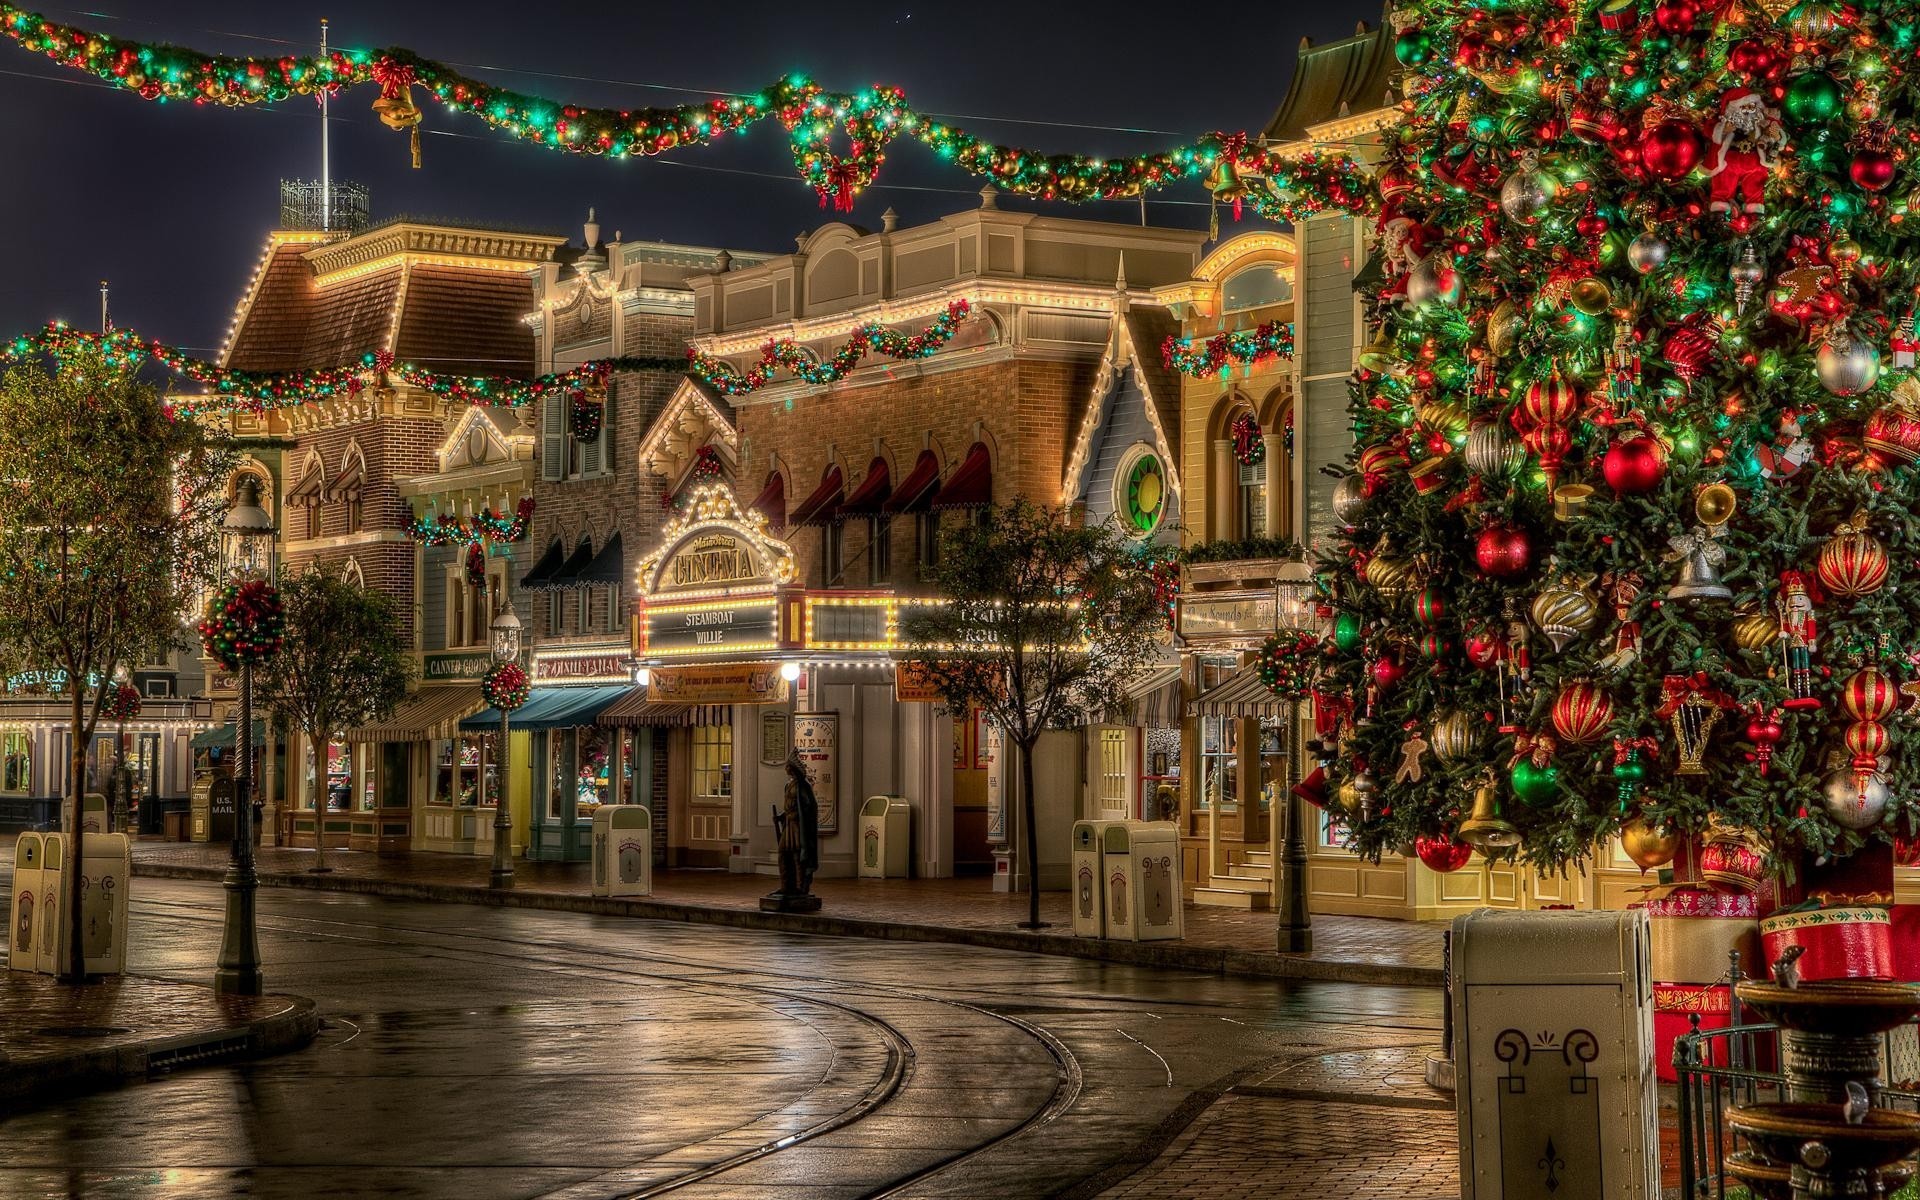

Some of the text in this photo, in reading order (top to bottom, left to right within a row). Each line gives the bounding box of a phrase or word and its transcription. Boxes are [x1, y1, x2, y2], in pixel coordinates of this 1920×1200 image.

[674, 548, 755, 585] CINEMA
[686, 611, 734, 626] STEAMBOAT
[696, 630, 723, 645] WILLIE
[430, 660, 460, 674] CANNED
[212, 806, 235, 814] MAIL
